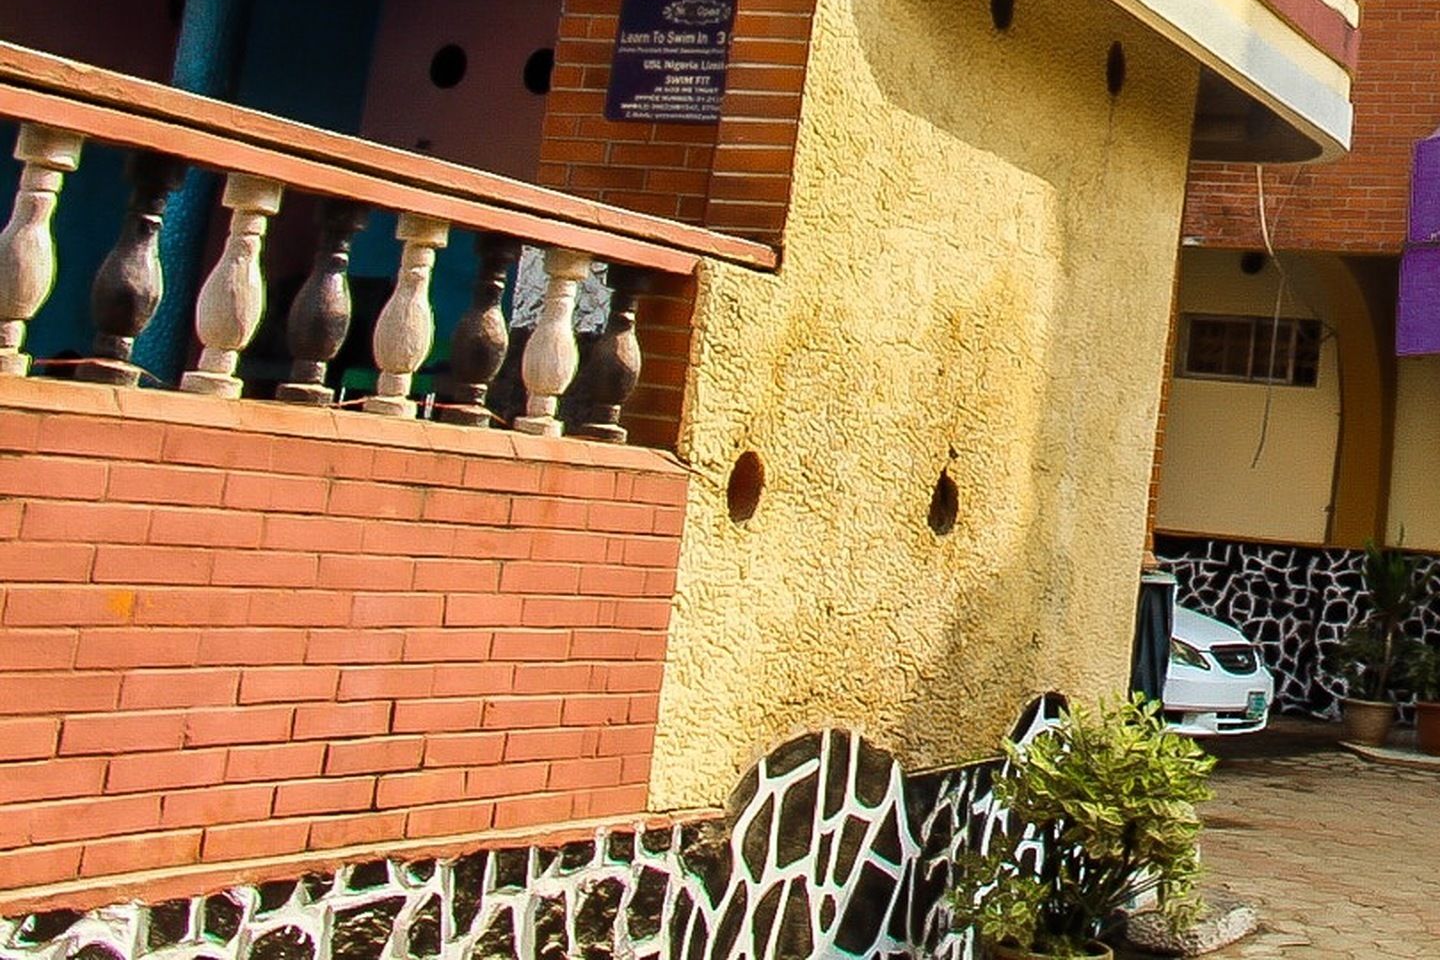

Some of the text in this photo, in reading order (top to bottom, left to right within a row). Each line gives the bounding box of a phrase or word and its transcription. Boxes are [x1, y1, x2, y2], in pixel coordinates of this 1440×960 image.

[620, 30, 650, 43] Learn
[653, 30, 665, 44] To
[667, 30, 696, 44] Swim
[697, 30, 709, 44] In
[664, 59, 698, 71] Nigeria
[664, 74, 694, 85] SWIM
